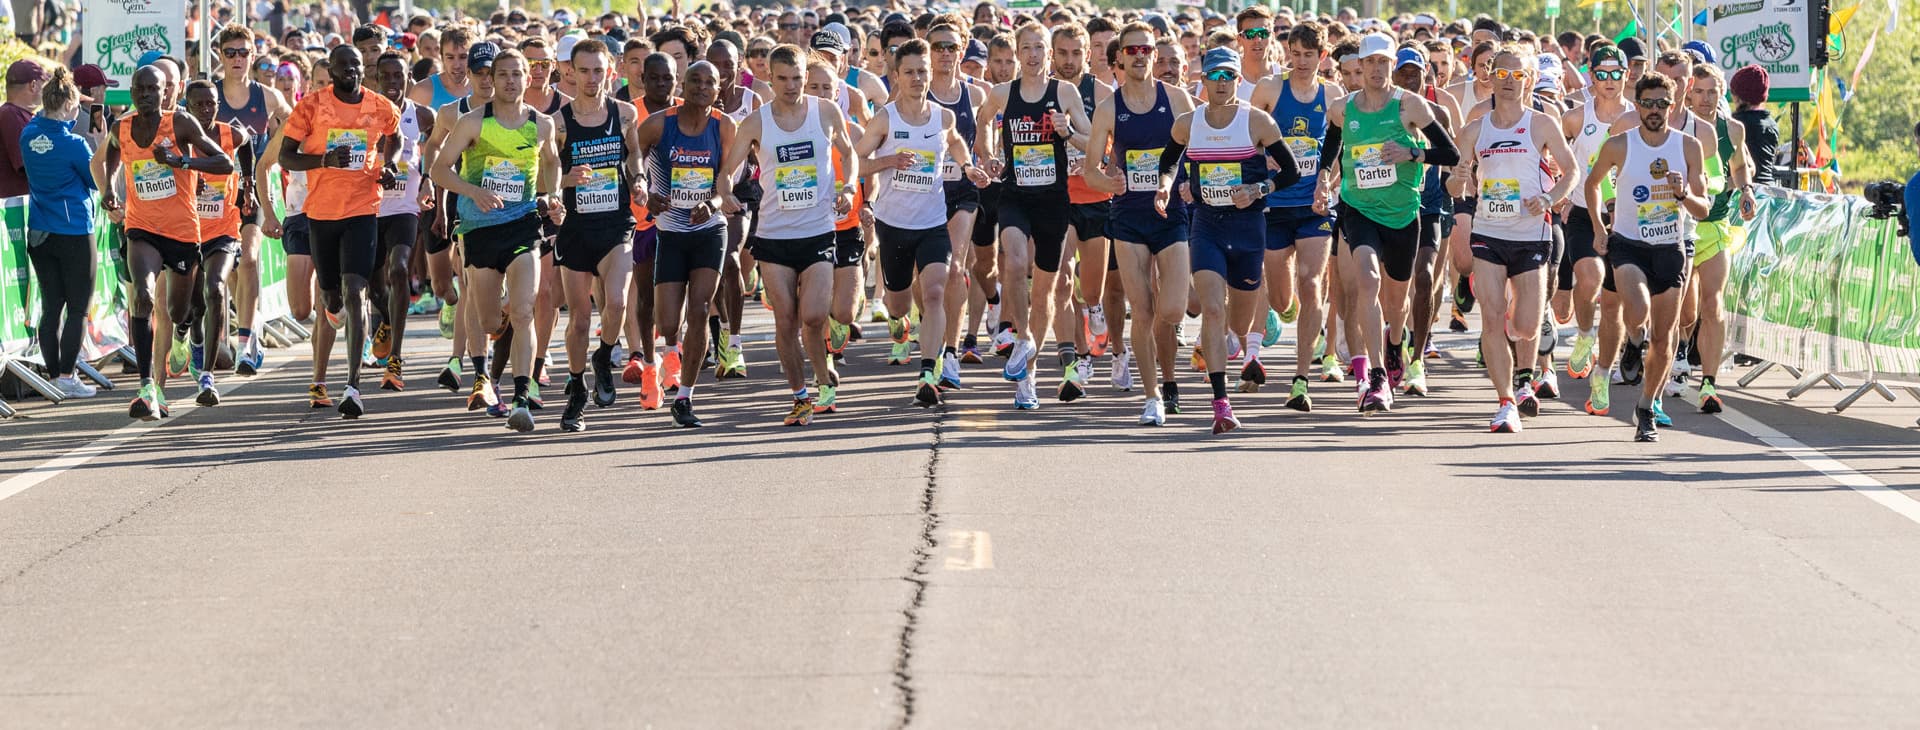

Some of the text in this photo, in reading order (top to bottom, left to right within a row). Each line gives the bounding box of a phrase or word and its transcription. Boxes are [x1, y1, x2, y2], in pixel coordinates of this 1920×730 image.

[1737, 61, 1799, 73] Mathon
[1009, 118, 1035, 131] WEST
[1011, 132, 1041, 143] VALLEY
[580, 142, 621, 154] RUNNING
[1480, 148, 1528, 156] playmakers
[678, 155, 711, 164] DEPOT
[893, 170, 933, 185] Jermann
[1016, 166, 1055, 178] Richards
[1359, 168, 1391, 180] Carter
[1133, 173, 1158, 184] Greg
[136, 178, 175, 193] M Rotich
[482, 178, 524, 194] Albertson
[577, 193, 618, 205] Sultanov
[783, 189, 813, 201] Lewis
[1202, 187, 1240, 199] Stinso
[1489, 201, 1514, 213] Crain
[1641, 222, 1678, 238] Cowart
